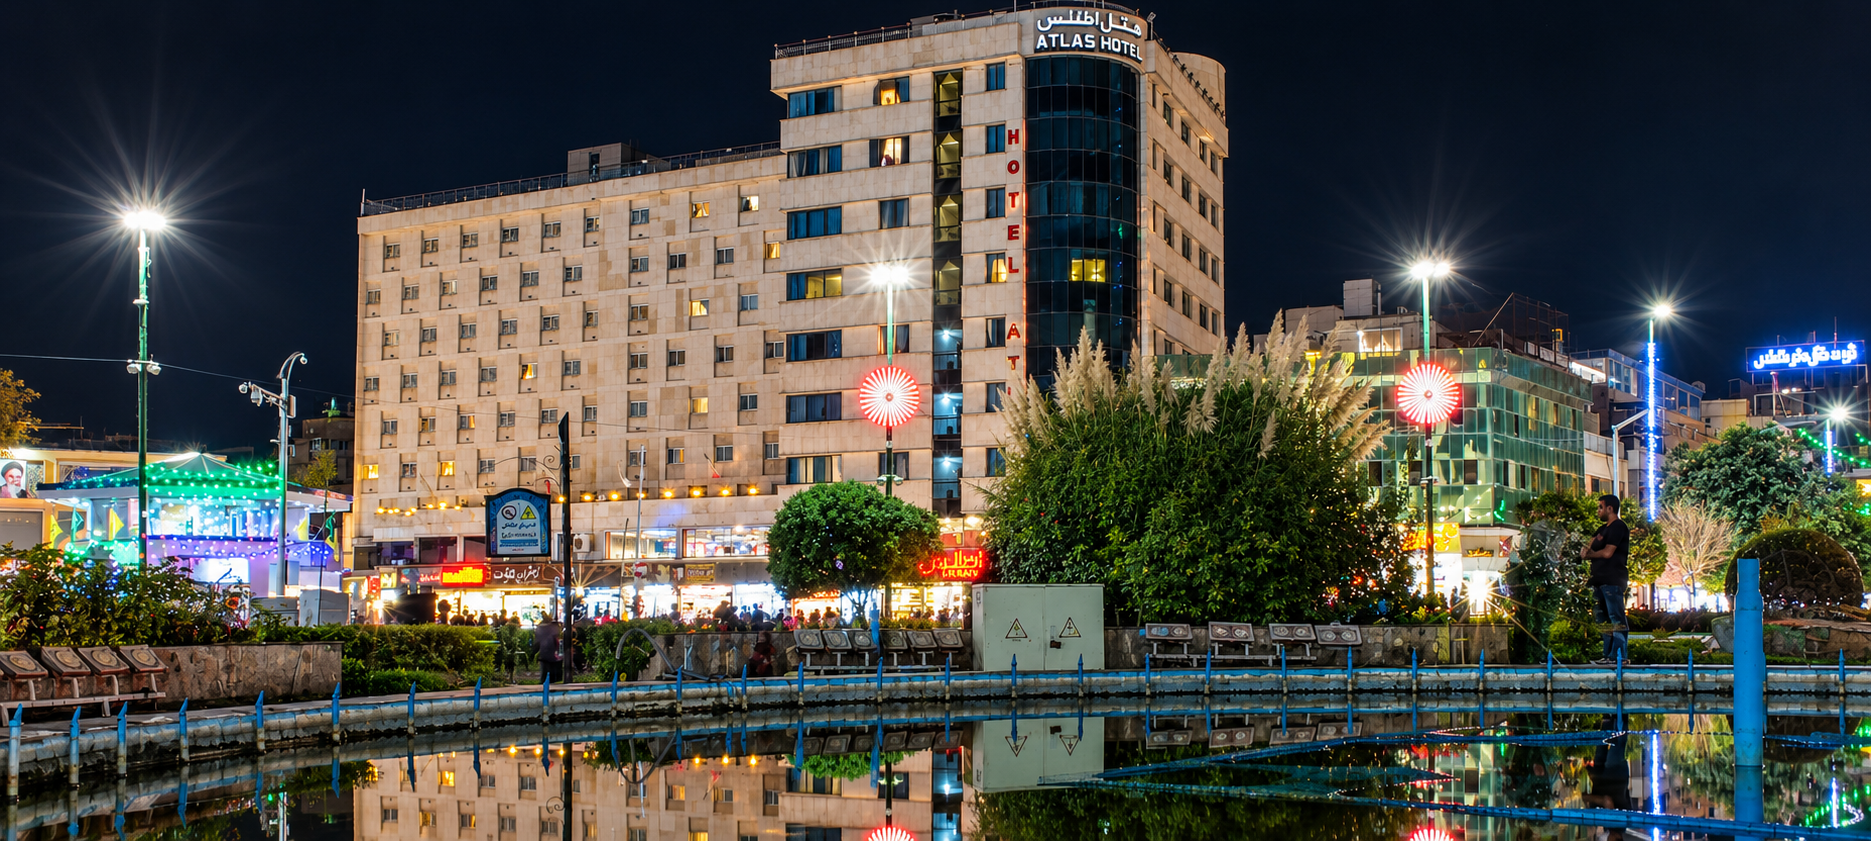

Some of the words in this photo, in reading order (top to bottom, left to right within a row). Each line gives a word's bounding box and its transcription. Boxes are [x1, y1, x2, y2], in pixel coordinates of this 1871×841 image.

[1100, 13, 1142, 36] هتل
[1036, 33, 1095, 49] ATLAS
[1101, 36, 1143, 61] HOTEL
[1007, 129, 1020, 274] HOTEL
